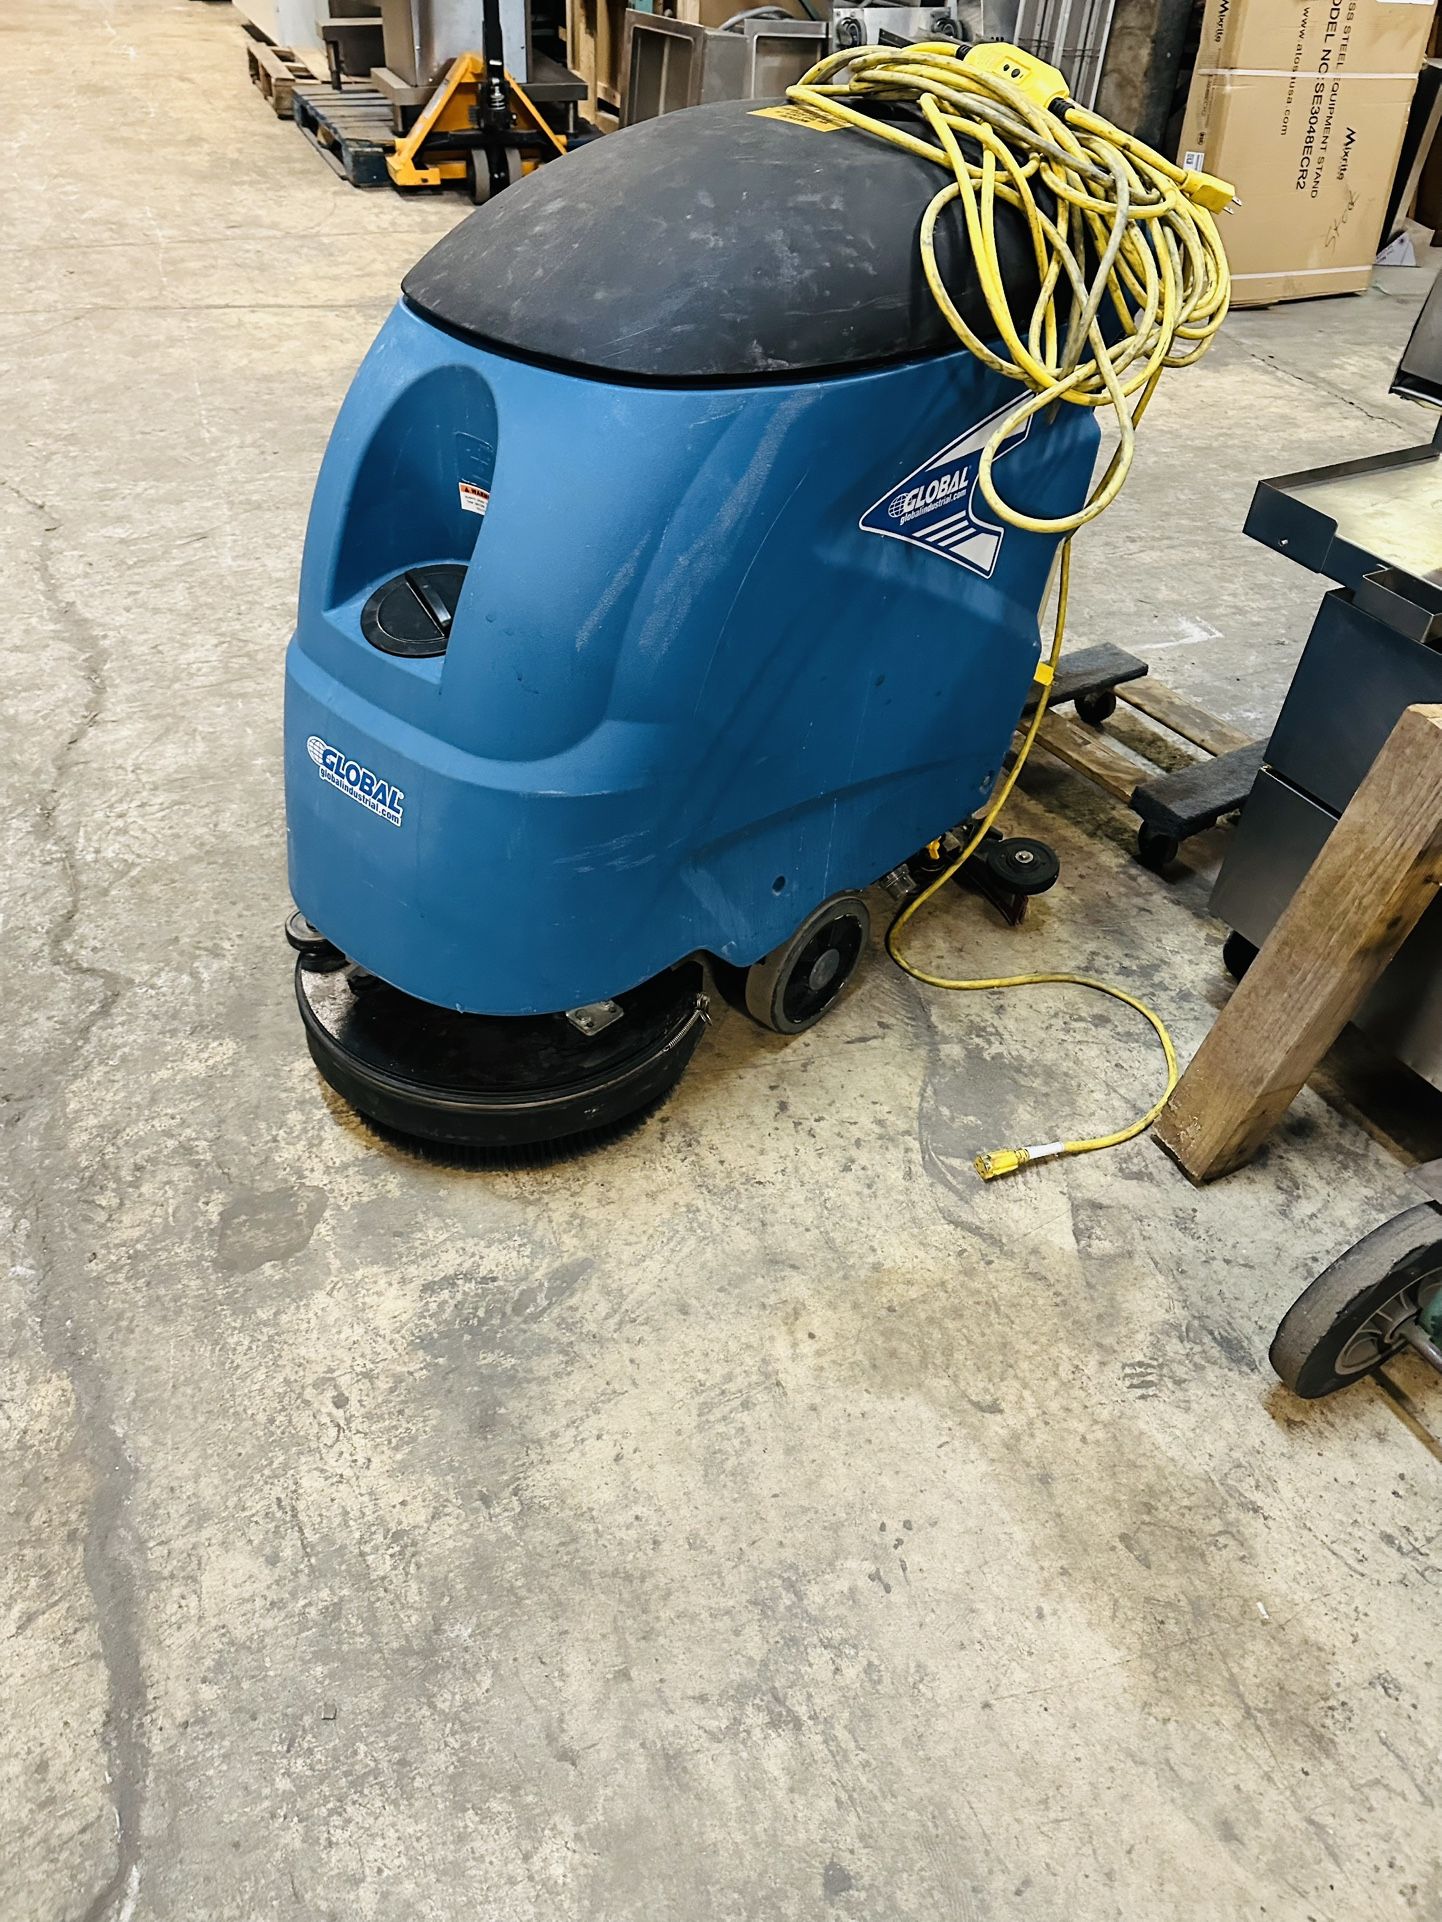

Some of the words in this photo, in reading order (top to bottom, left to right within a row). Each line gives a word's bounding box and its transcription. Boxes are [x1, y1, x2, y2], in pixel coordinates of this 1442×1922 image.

[1335, 25, 1352, 69] STEEL
[1336, 127, 1356, 180] Mixrite
[1311, 156, 1325, 199] STAND
[900, 489, 967, 526] globalindustrial.com
[903, 466, 969, 513] GLOBAL
[320, 767, 400, 825] globalindustrial.com
[321, 747, 402, 815] GLOBAL
